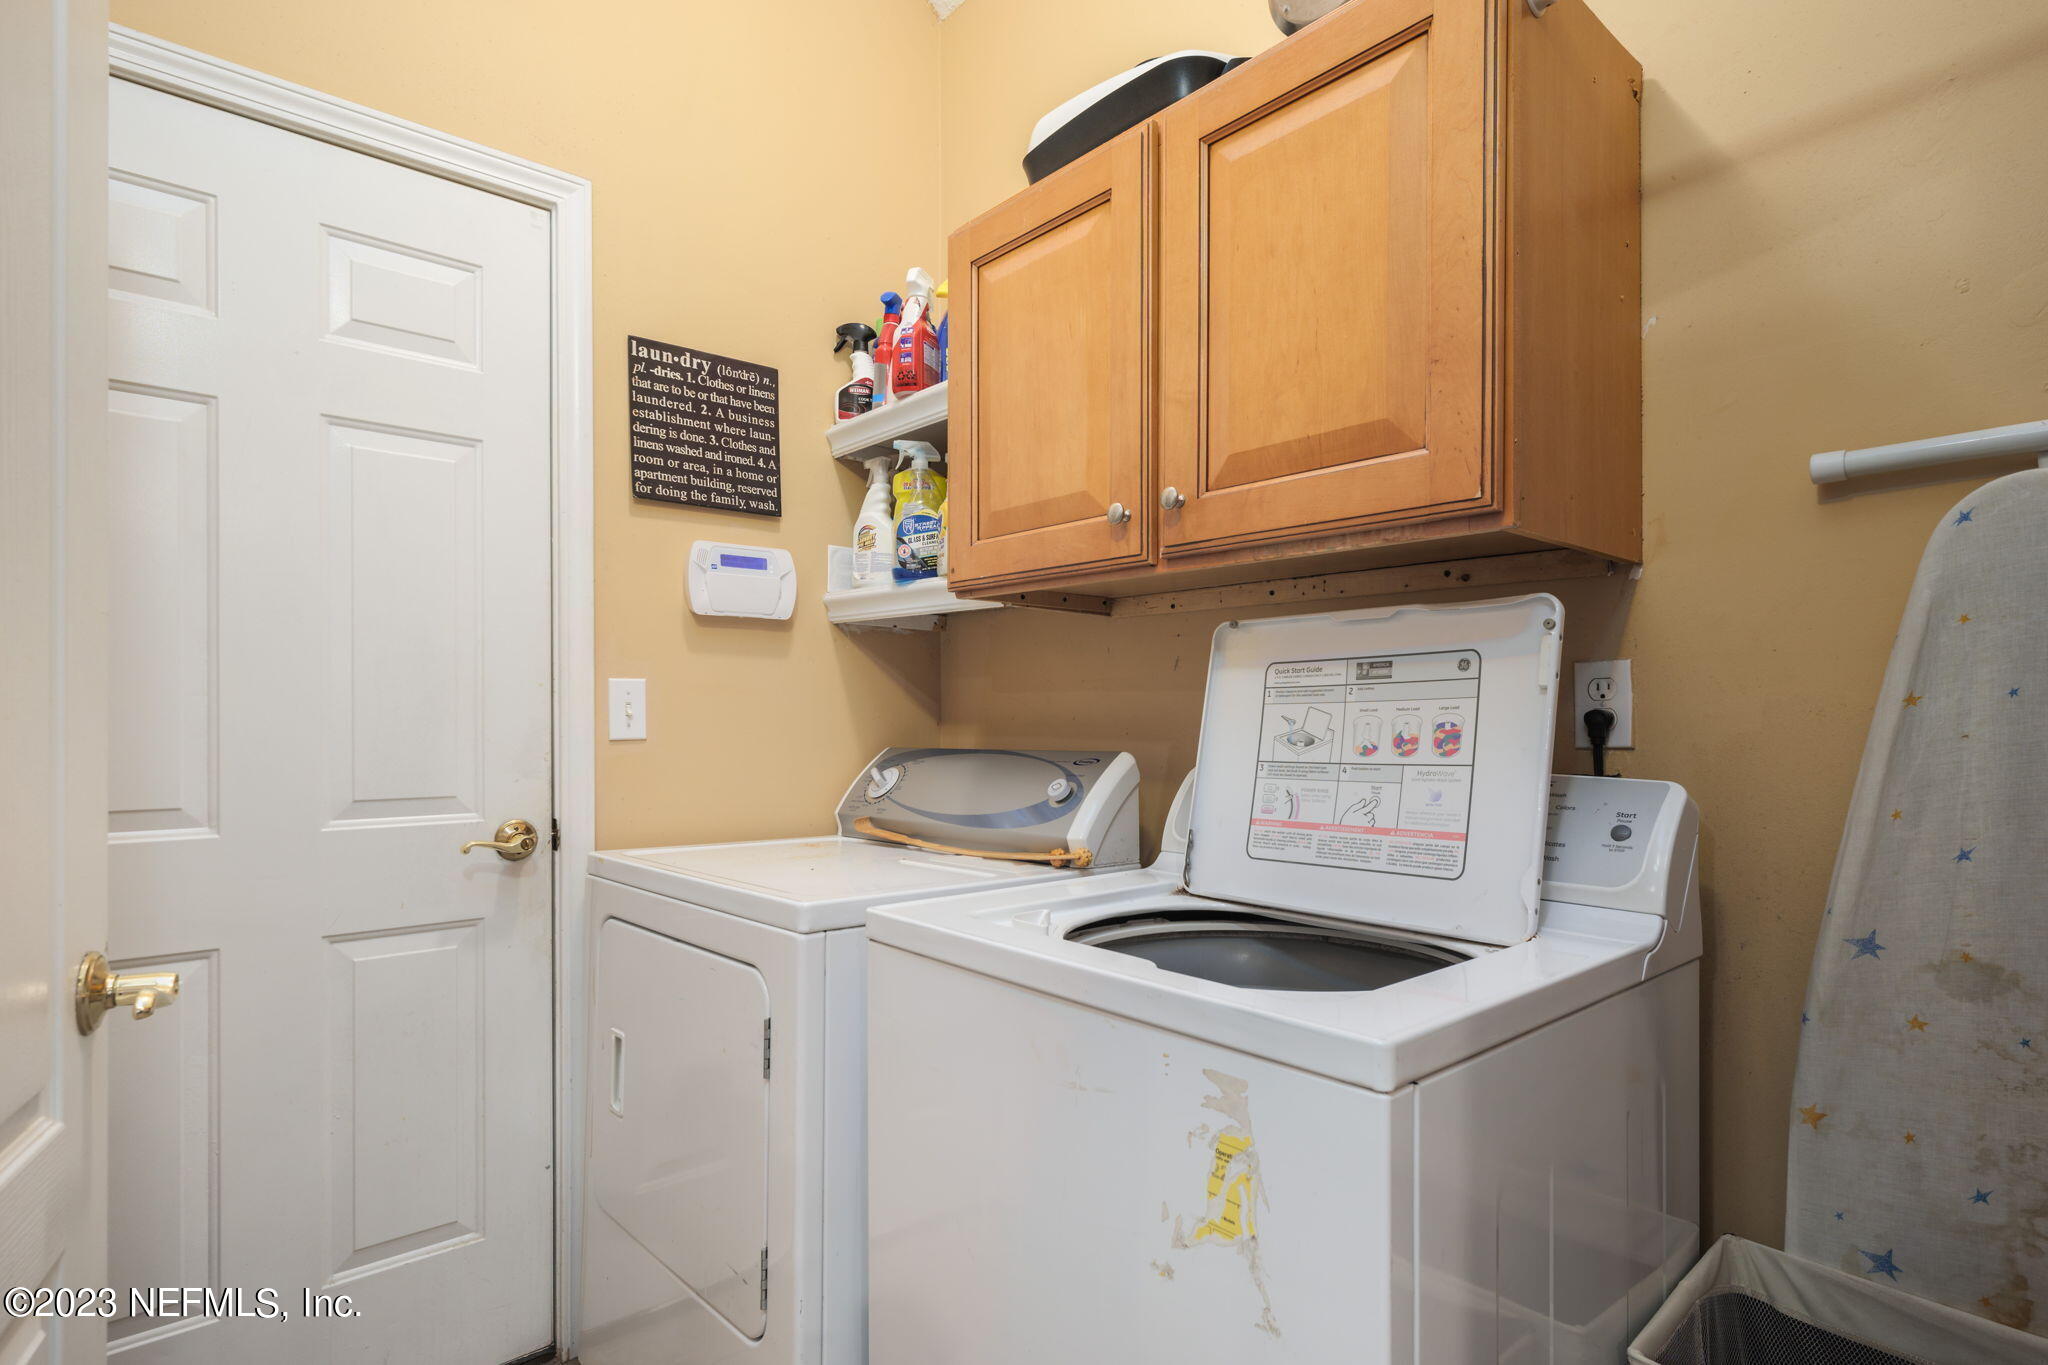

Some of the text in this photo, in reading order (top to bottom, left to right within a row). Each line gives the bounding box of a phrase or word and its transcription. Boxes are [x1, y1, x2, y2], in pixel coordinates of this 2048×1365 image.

[632, 376, 775, 414] that are to be or that have been
[633, 362, 775, 400] pl. -dries. 1. Clothes or linens
[632, 390, 774, 427] laundered. 2. A business
[632, 408, 775, 441] establishment where laun-
[633, 422, 775, 456] dering is done. 3. Clothes and
[633, 436, 776, 470] linens washed and ironed. 4. A
[634, 453, 778, 483] room or area, in a home or
[634, 468, 777, 497] apartment building, reserved
[635, 481, 652, 493] for
[656, 484, 687, 500] doing
[691, 490, 707, 501] the
[749, 500, 778, 512] wash.
[908, 535, 921, 544] GLASS
